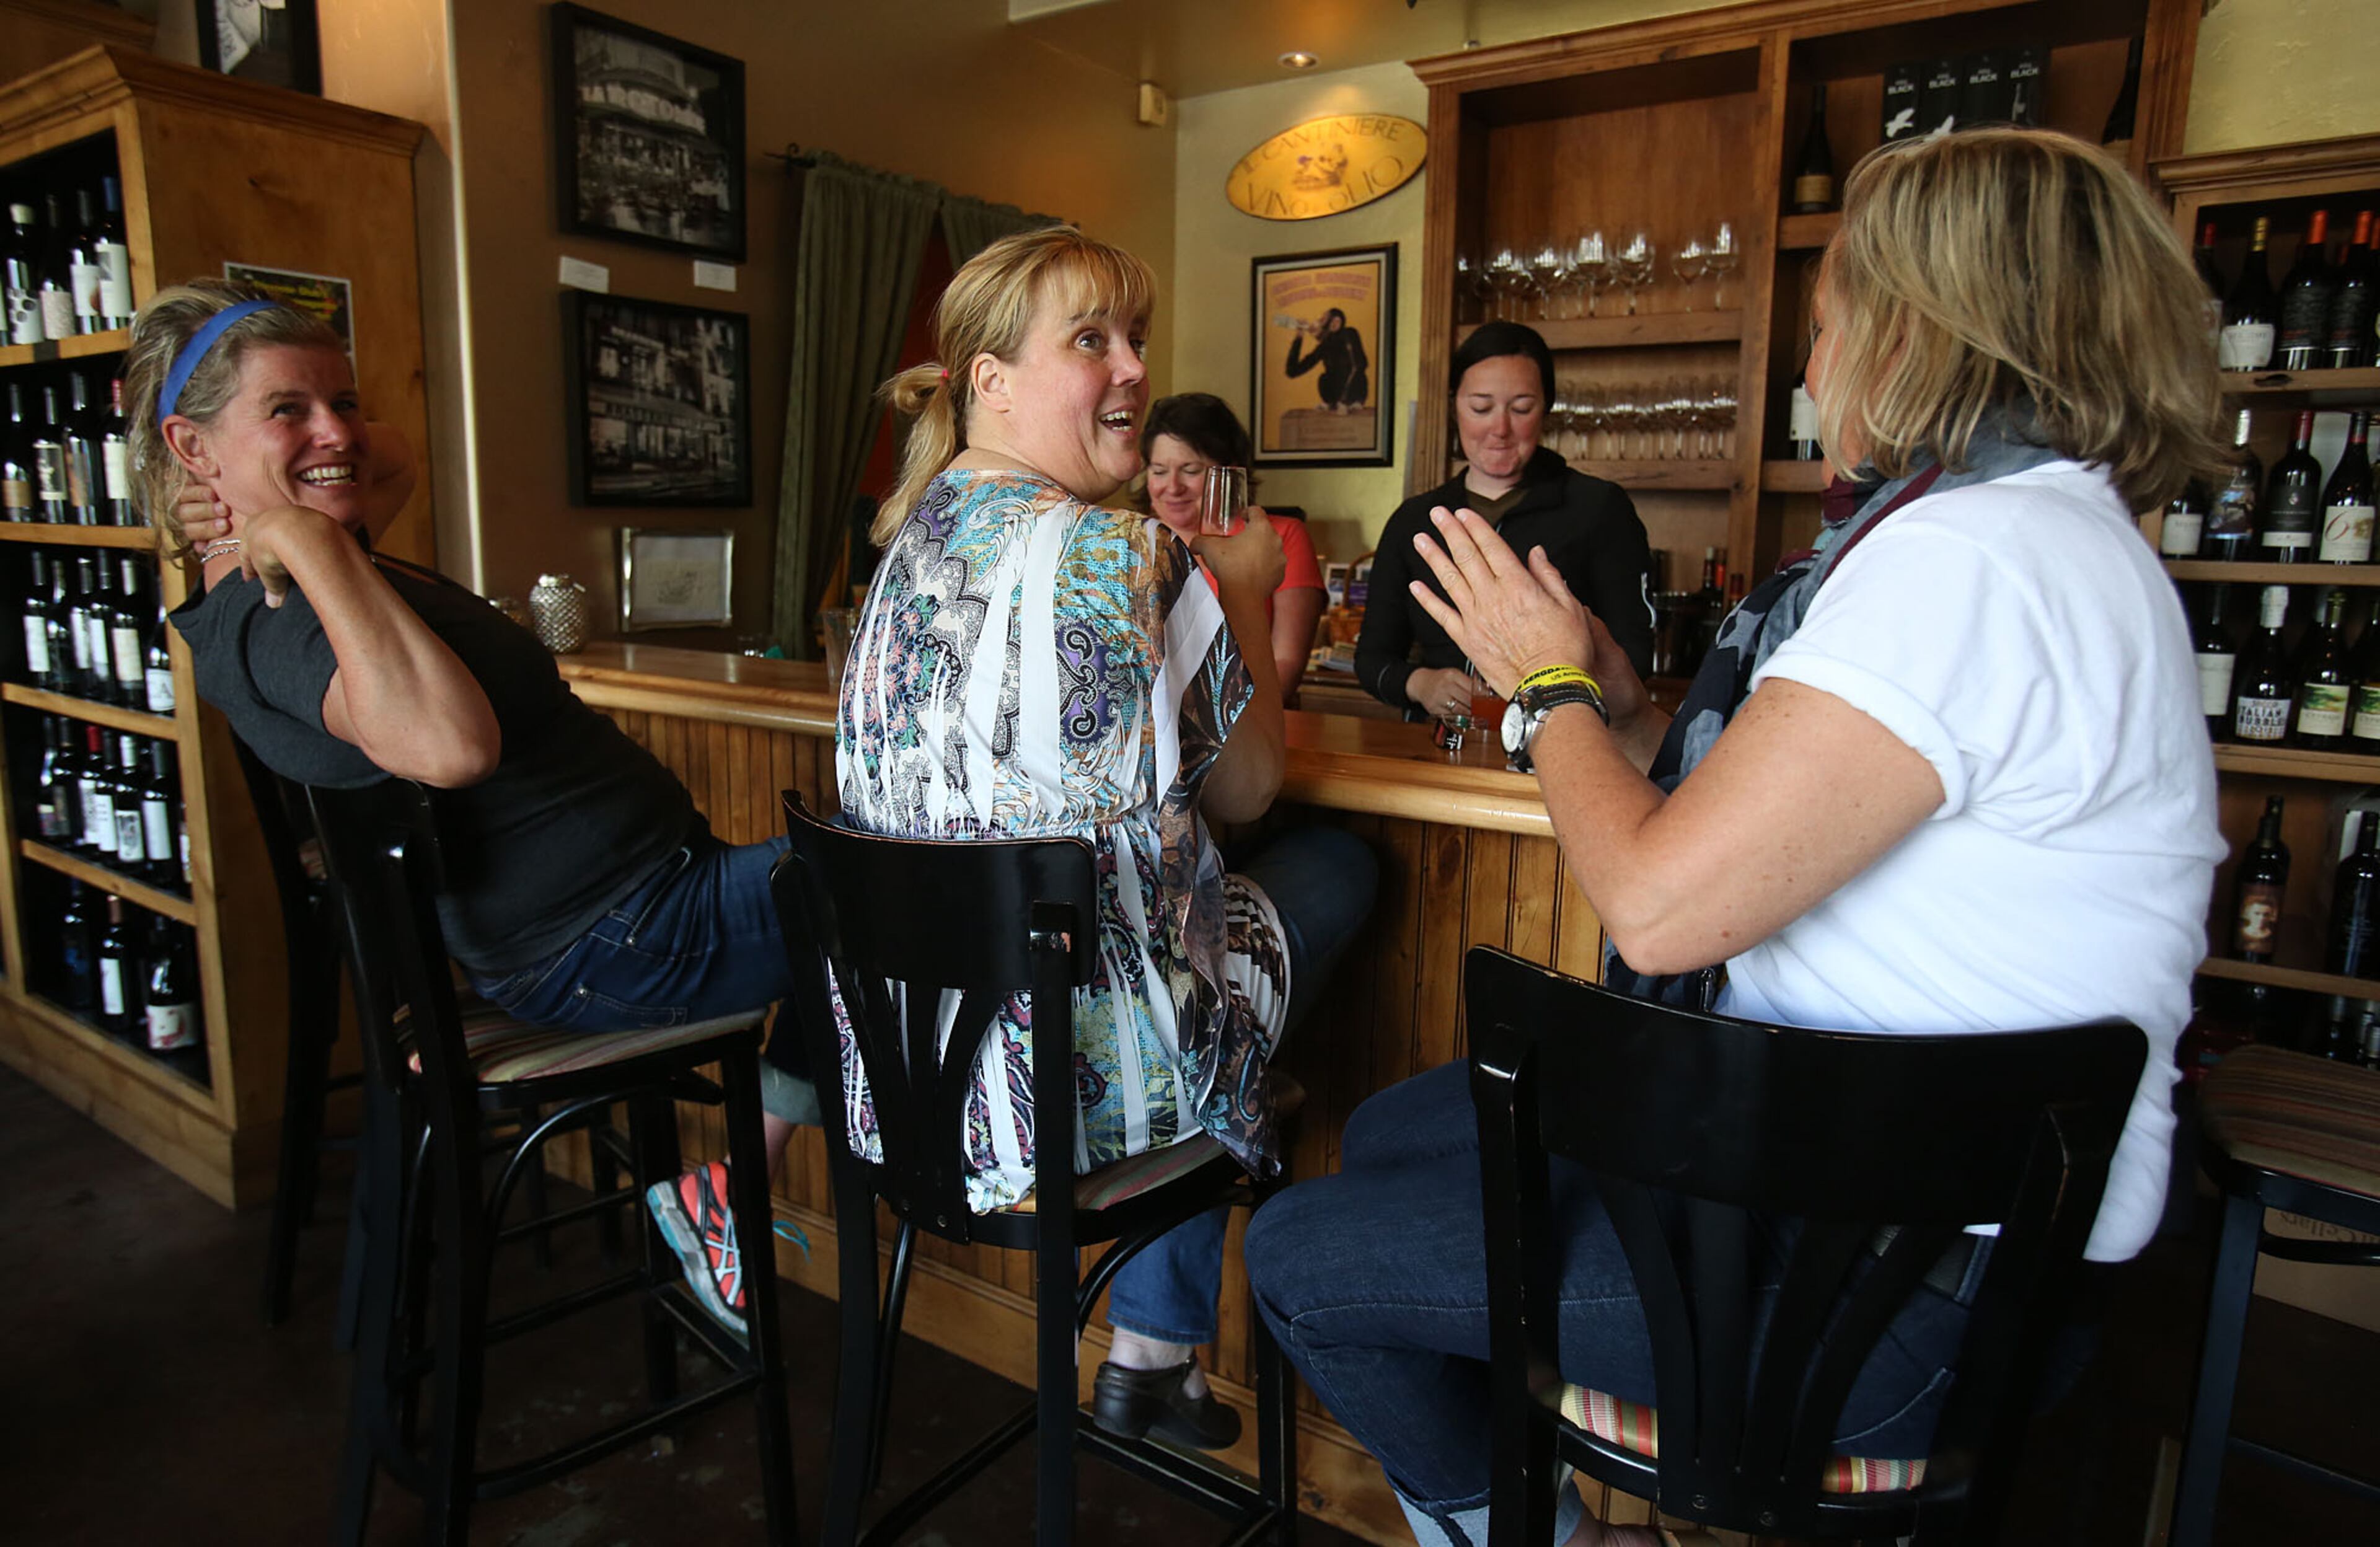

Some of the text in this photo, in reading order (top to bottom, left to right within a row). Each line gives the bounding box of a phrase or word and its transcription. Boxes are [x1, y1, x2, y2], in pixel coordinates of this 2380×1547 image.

[1969, 73, 1998, 84] BLACK
[2010, 66, 2039, 79] BLACK
[1888, 83, 1914, 95] BLACK
[1929, 77, 1956, 89] BLACK
